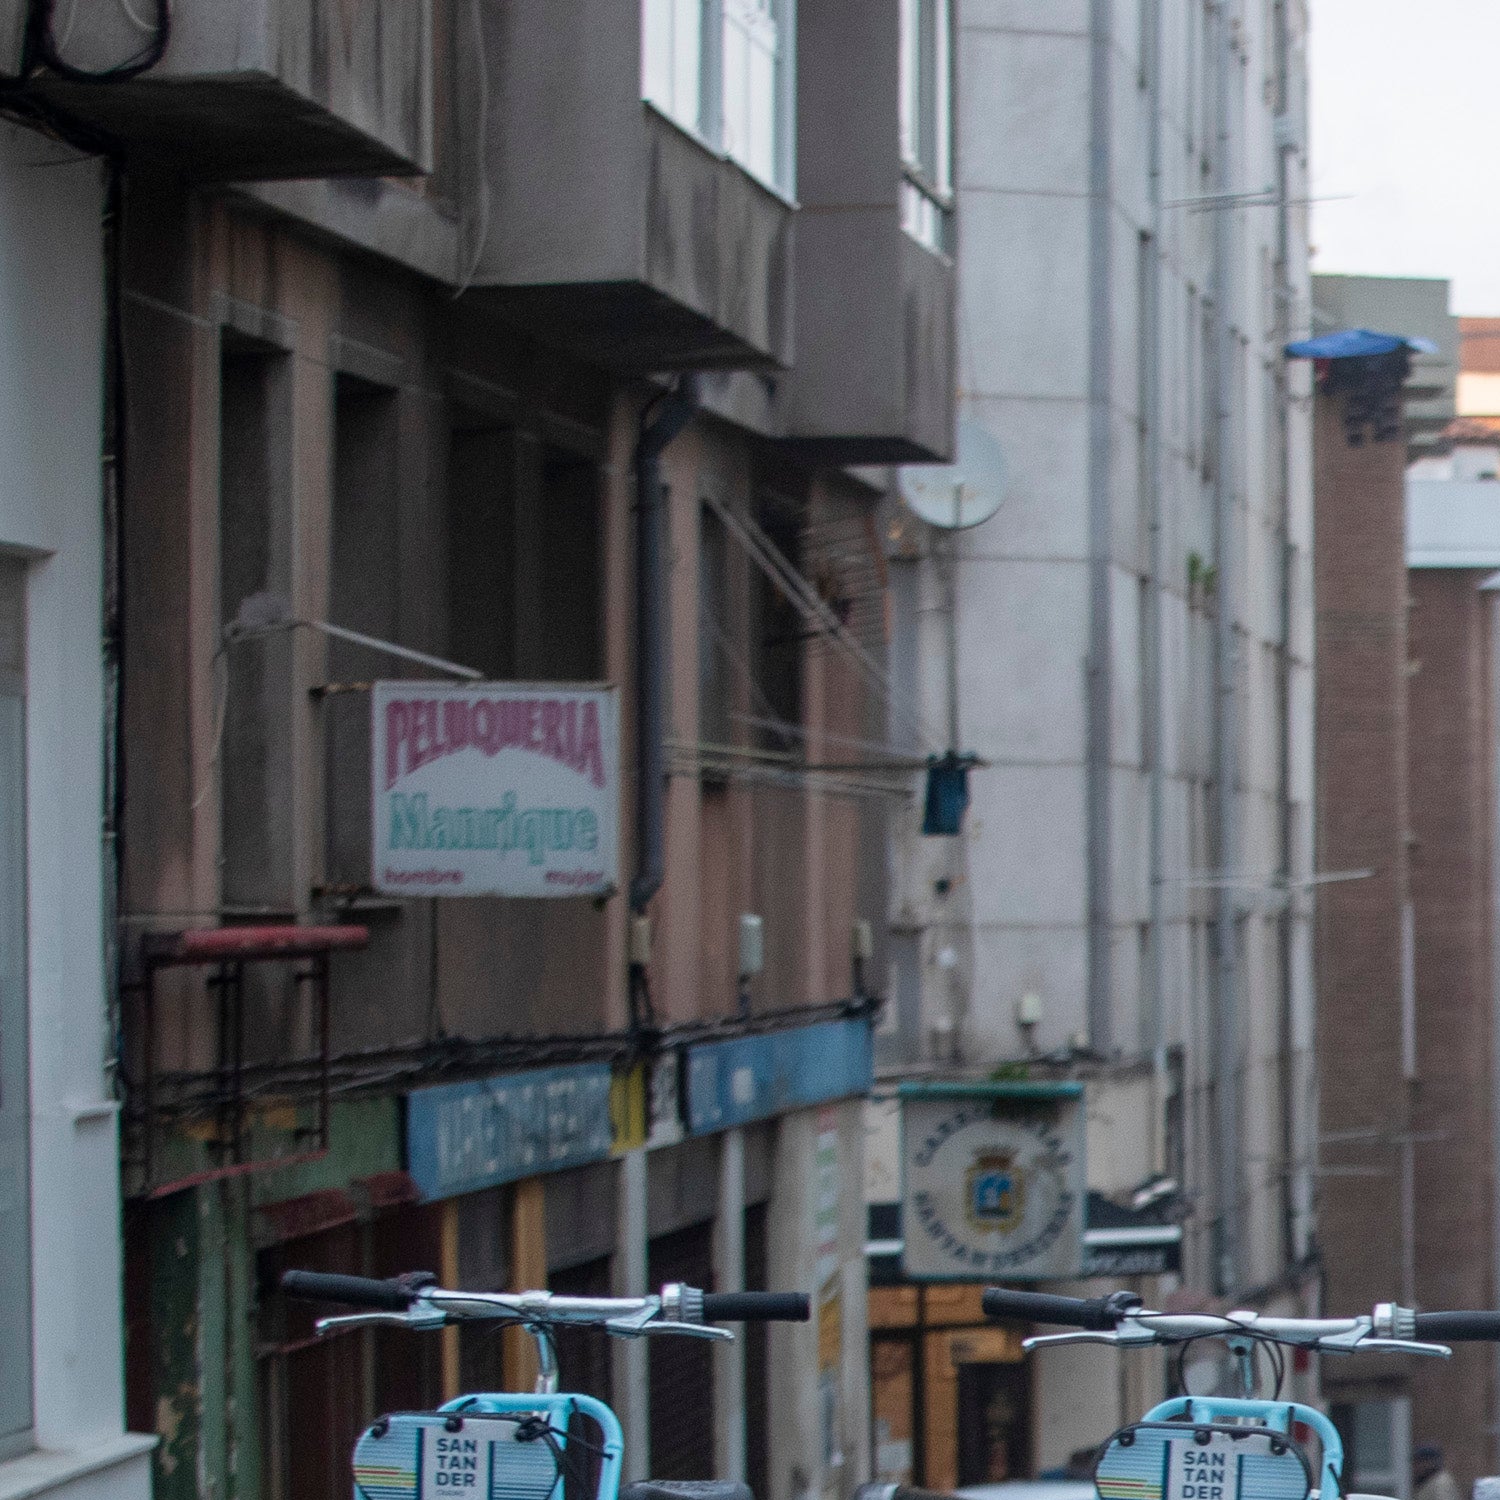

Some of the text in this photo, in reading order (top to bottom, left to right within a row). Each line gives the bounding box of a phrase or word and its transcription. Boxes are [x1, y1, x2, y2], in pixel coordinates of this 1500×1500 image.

[390, 789, 598, 867] Manrique
[384, 867, 605, 889] hombre mujer
[436, 1438, 476, 1453] SAN
[436, 1455, 476, 1470] TAN
[1183, 1451, 1225, 1466] SAN
[436, 1472, 475, 1487] DER
[1183, 1468, 1225, 1483] TAN
[1182, 1485, 1223, 1500] DER
